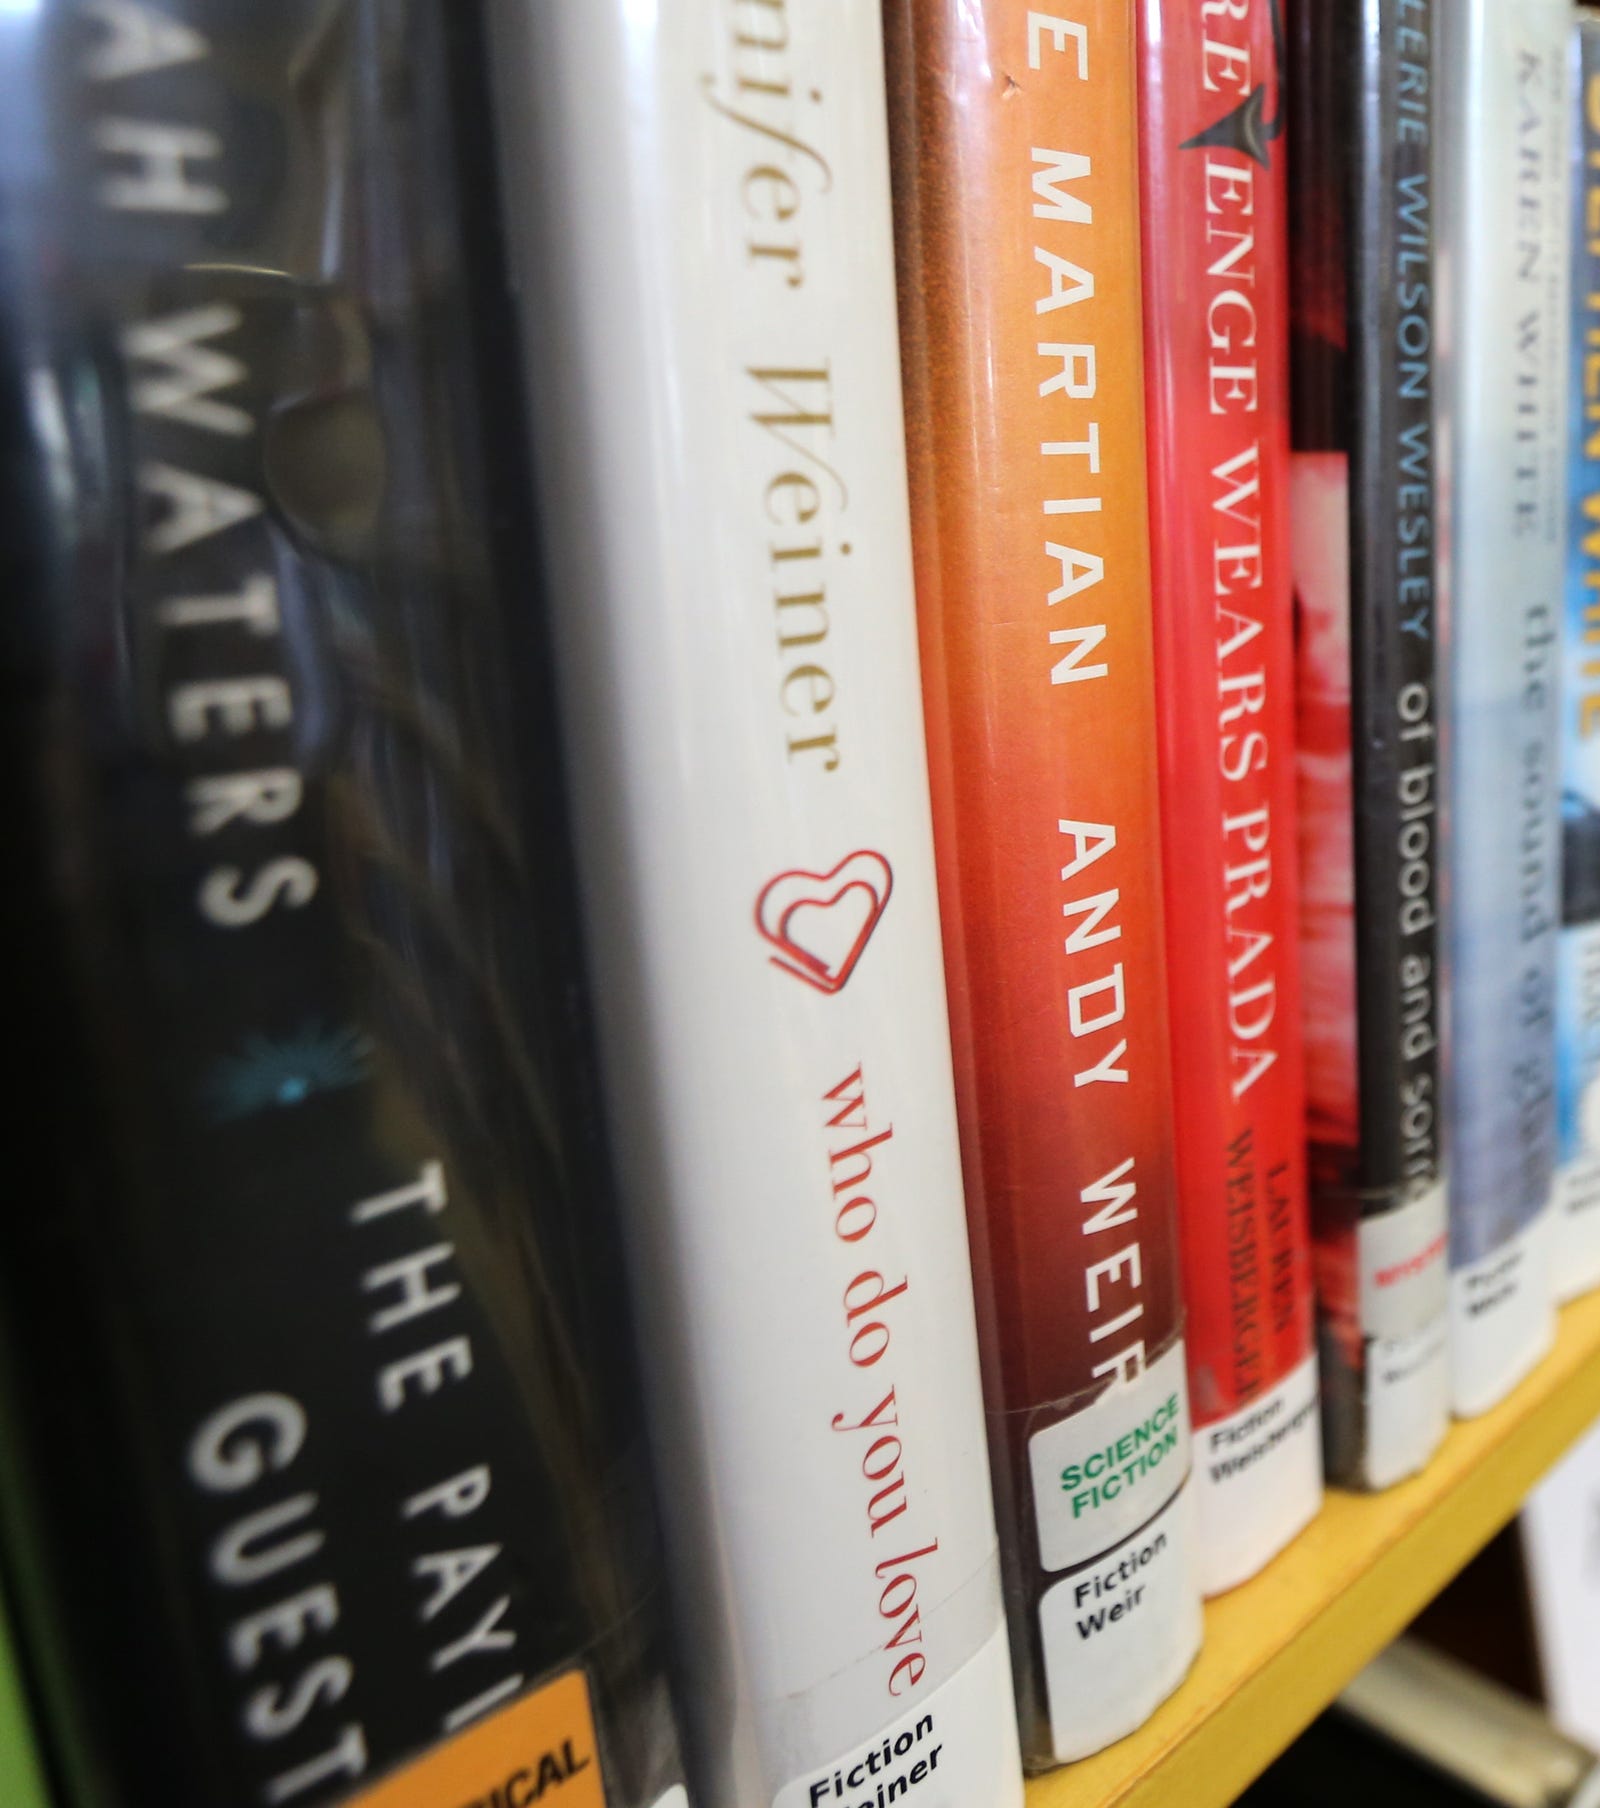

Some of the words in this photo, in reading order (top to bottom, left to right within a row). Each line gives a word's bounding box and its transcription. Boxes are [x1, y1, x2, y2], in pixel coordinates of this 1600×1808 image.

[1027, 10, 1088, 81] E
[1513, 48, 1543, 284] KAREN
[1397, 173, 1431, 399] WILSON
[1029, 146, 1108, 685] MARTIAN
[1512, 309, 1542, 539] WHITE
[118, 302, 320, 930] WATERS
[744, 357, 852, 773] Weiner
[1210, 438, 1268, 782] WEARS
[1396, 423, 1430, 641] WESLEY
[1399, 681, 1436, 741] of
[1522, 603, 1557, 711] the
[1400, 765, 1436, 937] blood
[1057, 818, 1129, 1088] ANDY
[1220, 808, 1277, 1104] PRADA
[1401, 951, 1439, 1062] and
[819, 1061, 895, 1243] who
[349, 1160, 474, 1412] THE
[842, 1275, 909, 1368] do
[1265, 1160, 1297, 1336] LAUREN
[831, 1381, 909, 1537] you
[1060, 1393, 1180, 1492] SCIENCE
[1070, 1425, 1178, 1519] FICTION
[187, 1390, 370, 1805] GUEST
[875, 1534, 940, 1698] love
[1073, 1531, 1168, 1609] Fiction
[1075, 1583, 1147, 1641] Weir
[465, 1738, 592, 1808] ICAL
[808, 1714, 934, 1808] Fiction
